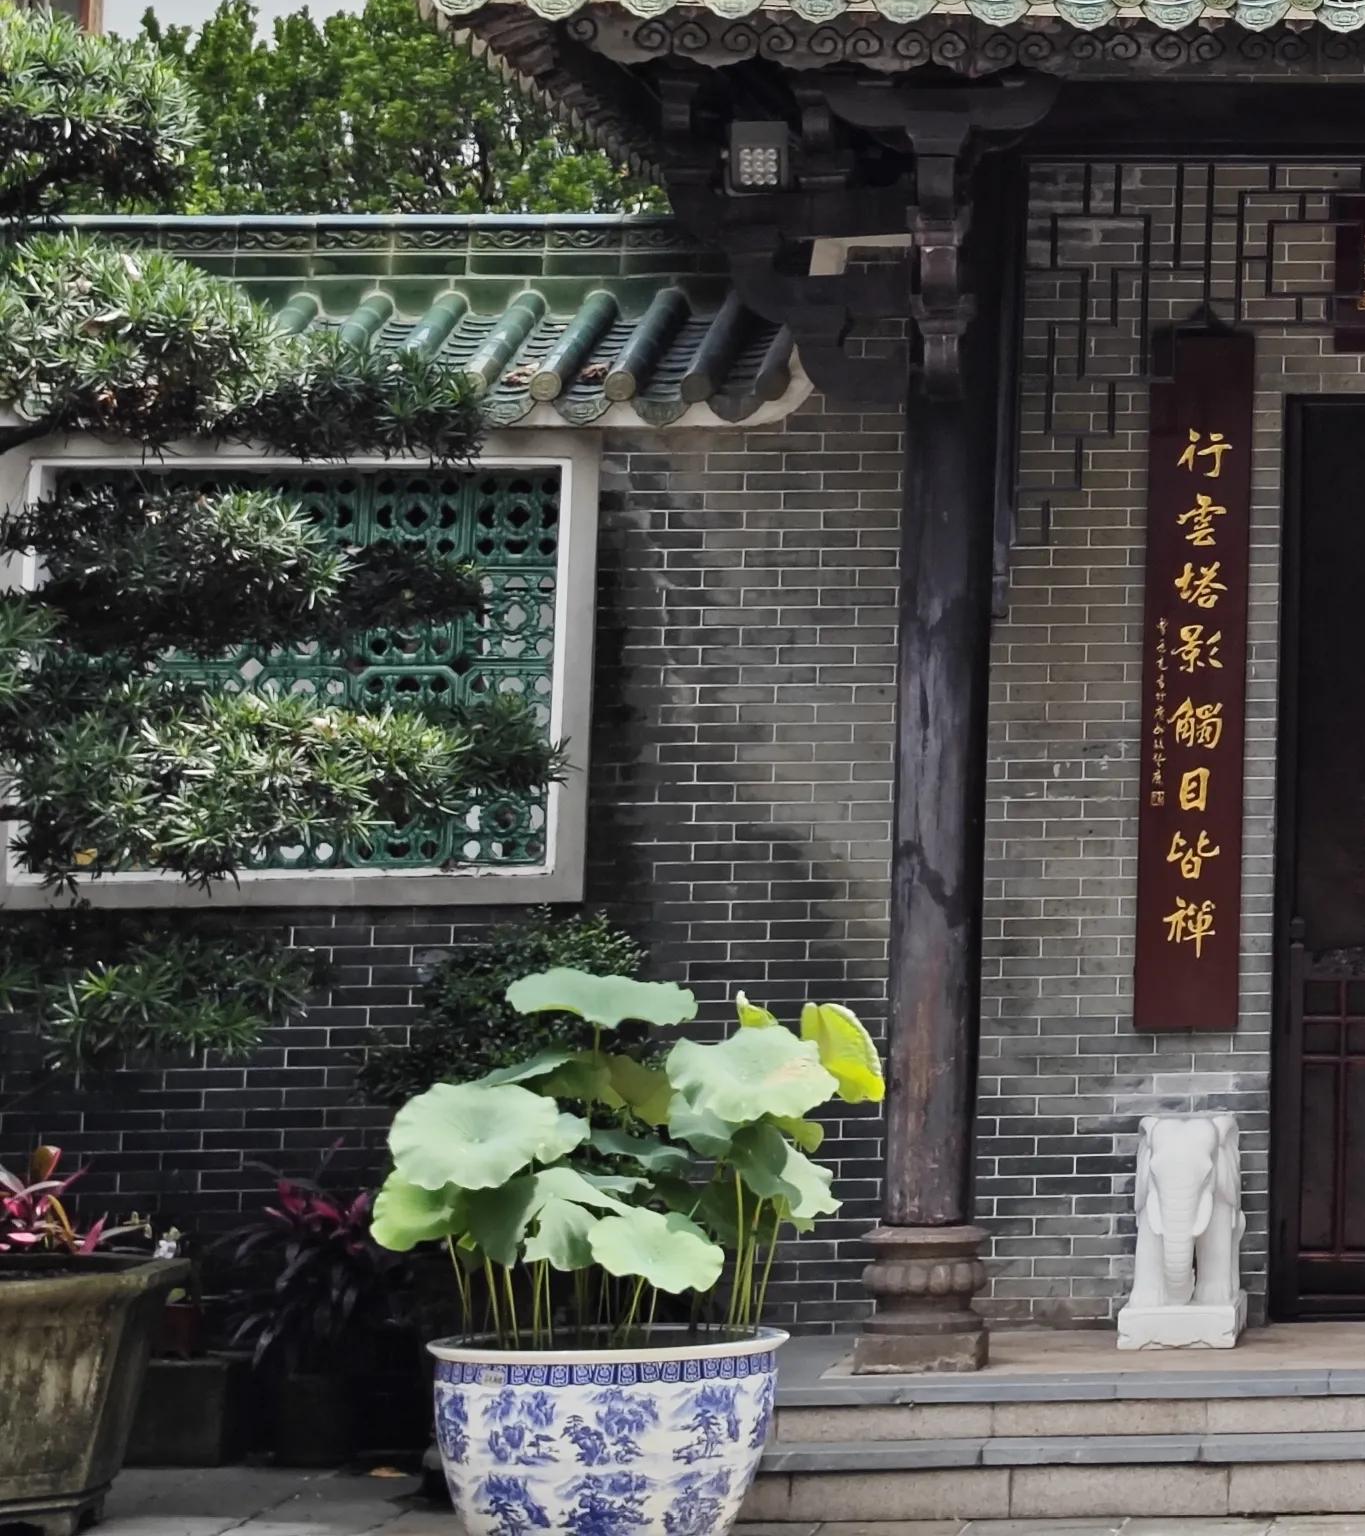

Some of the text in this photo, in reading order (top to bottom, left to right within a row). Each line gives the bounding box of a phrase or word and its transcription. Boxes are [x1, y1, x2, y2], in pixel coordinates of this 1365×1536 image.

[1162, 428, 1233, 959] 行雲塔影觸目皆禪
